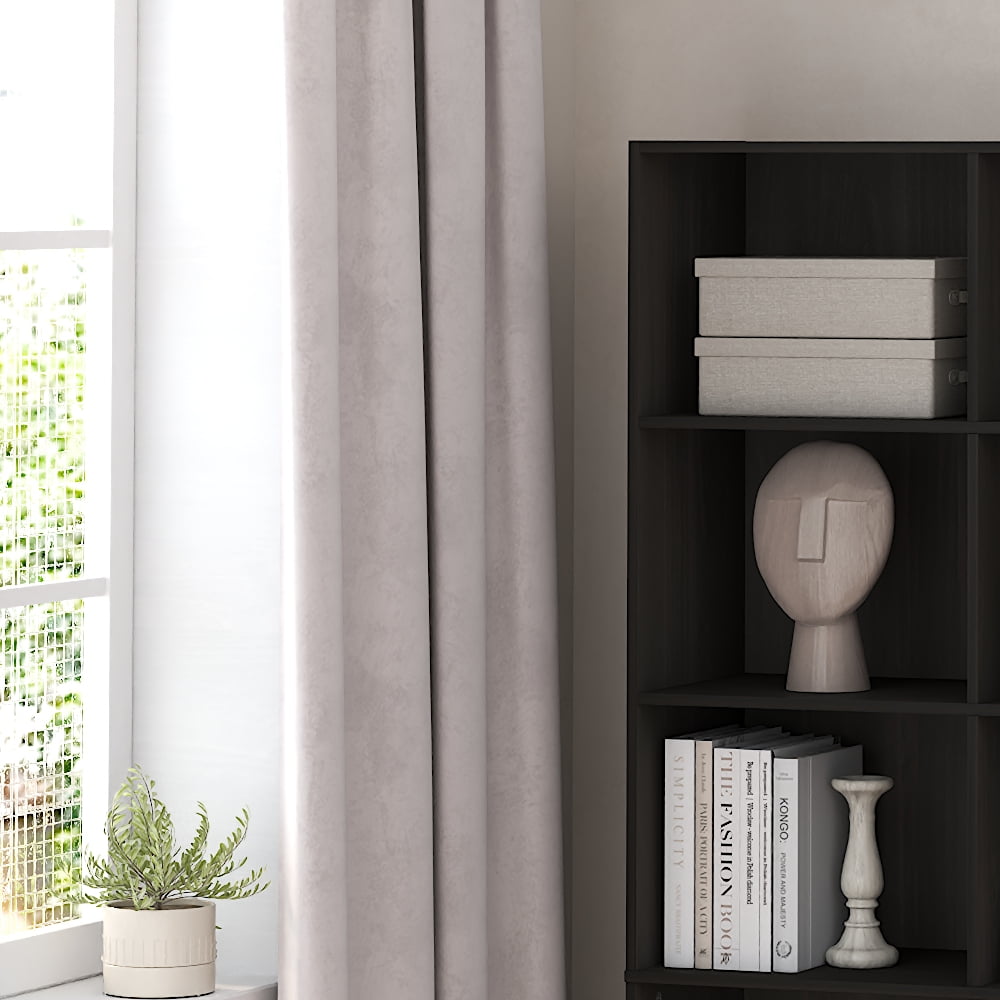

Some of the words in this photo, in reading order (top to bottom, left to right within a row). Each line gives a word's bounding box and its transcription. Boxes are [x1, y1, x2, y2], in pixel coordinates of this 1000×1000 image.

[720, 752, 733, 796] THE
[673, 756, 684, 869] SIMPLICITY
[779, 797, 790, 843] KONGO:
[720, 803, 733, 896] FASHION
[699, 913, 708, 936] CITY
